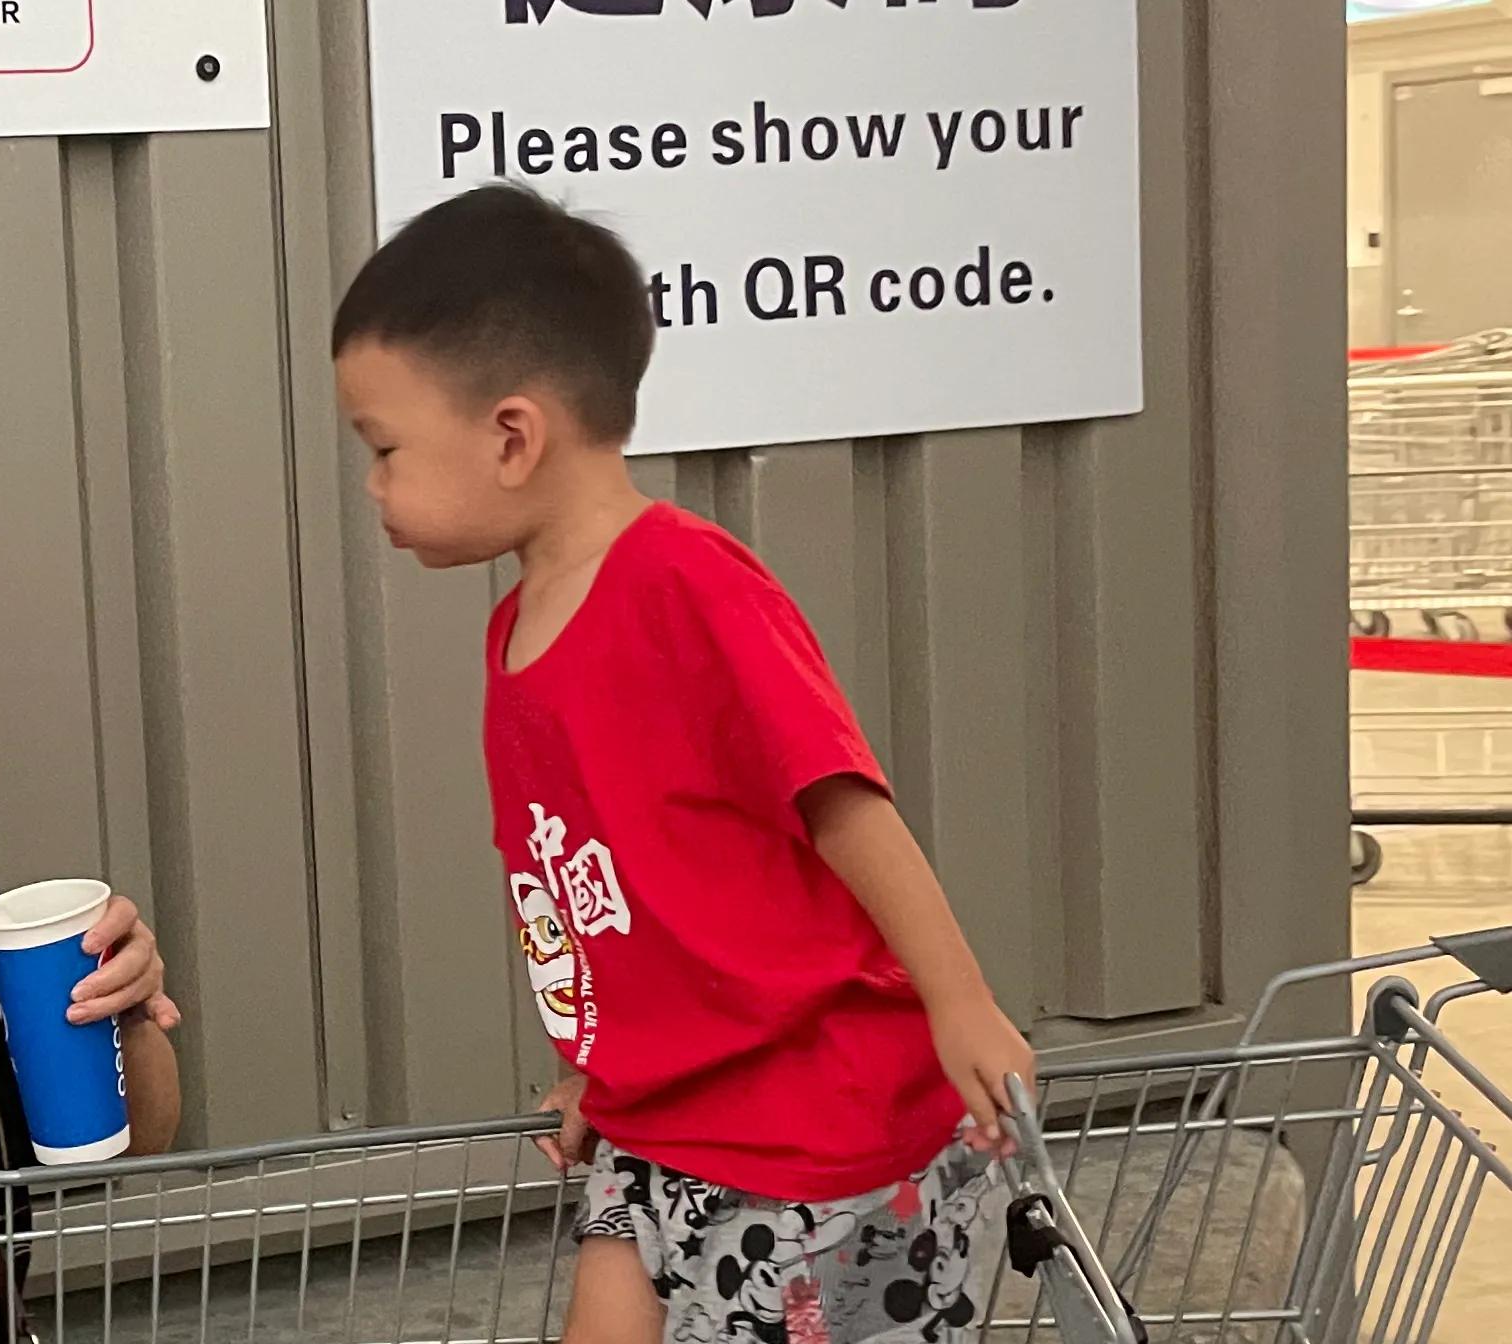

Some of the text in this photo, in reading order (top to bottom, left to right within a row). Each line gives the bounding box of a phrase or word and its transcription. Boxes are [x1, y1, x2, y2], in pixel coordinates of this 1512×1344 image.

[441, 100, 1083, 180] Please show your
[744, 255, 846, 321] QR
[870, 245, 1055, 313] code.
